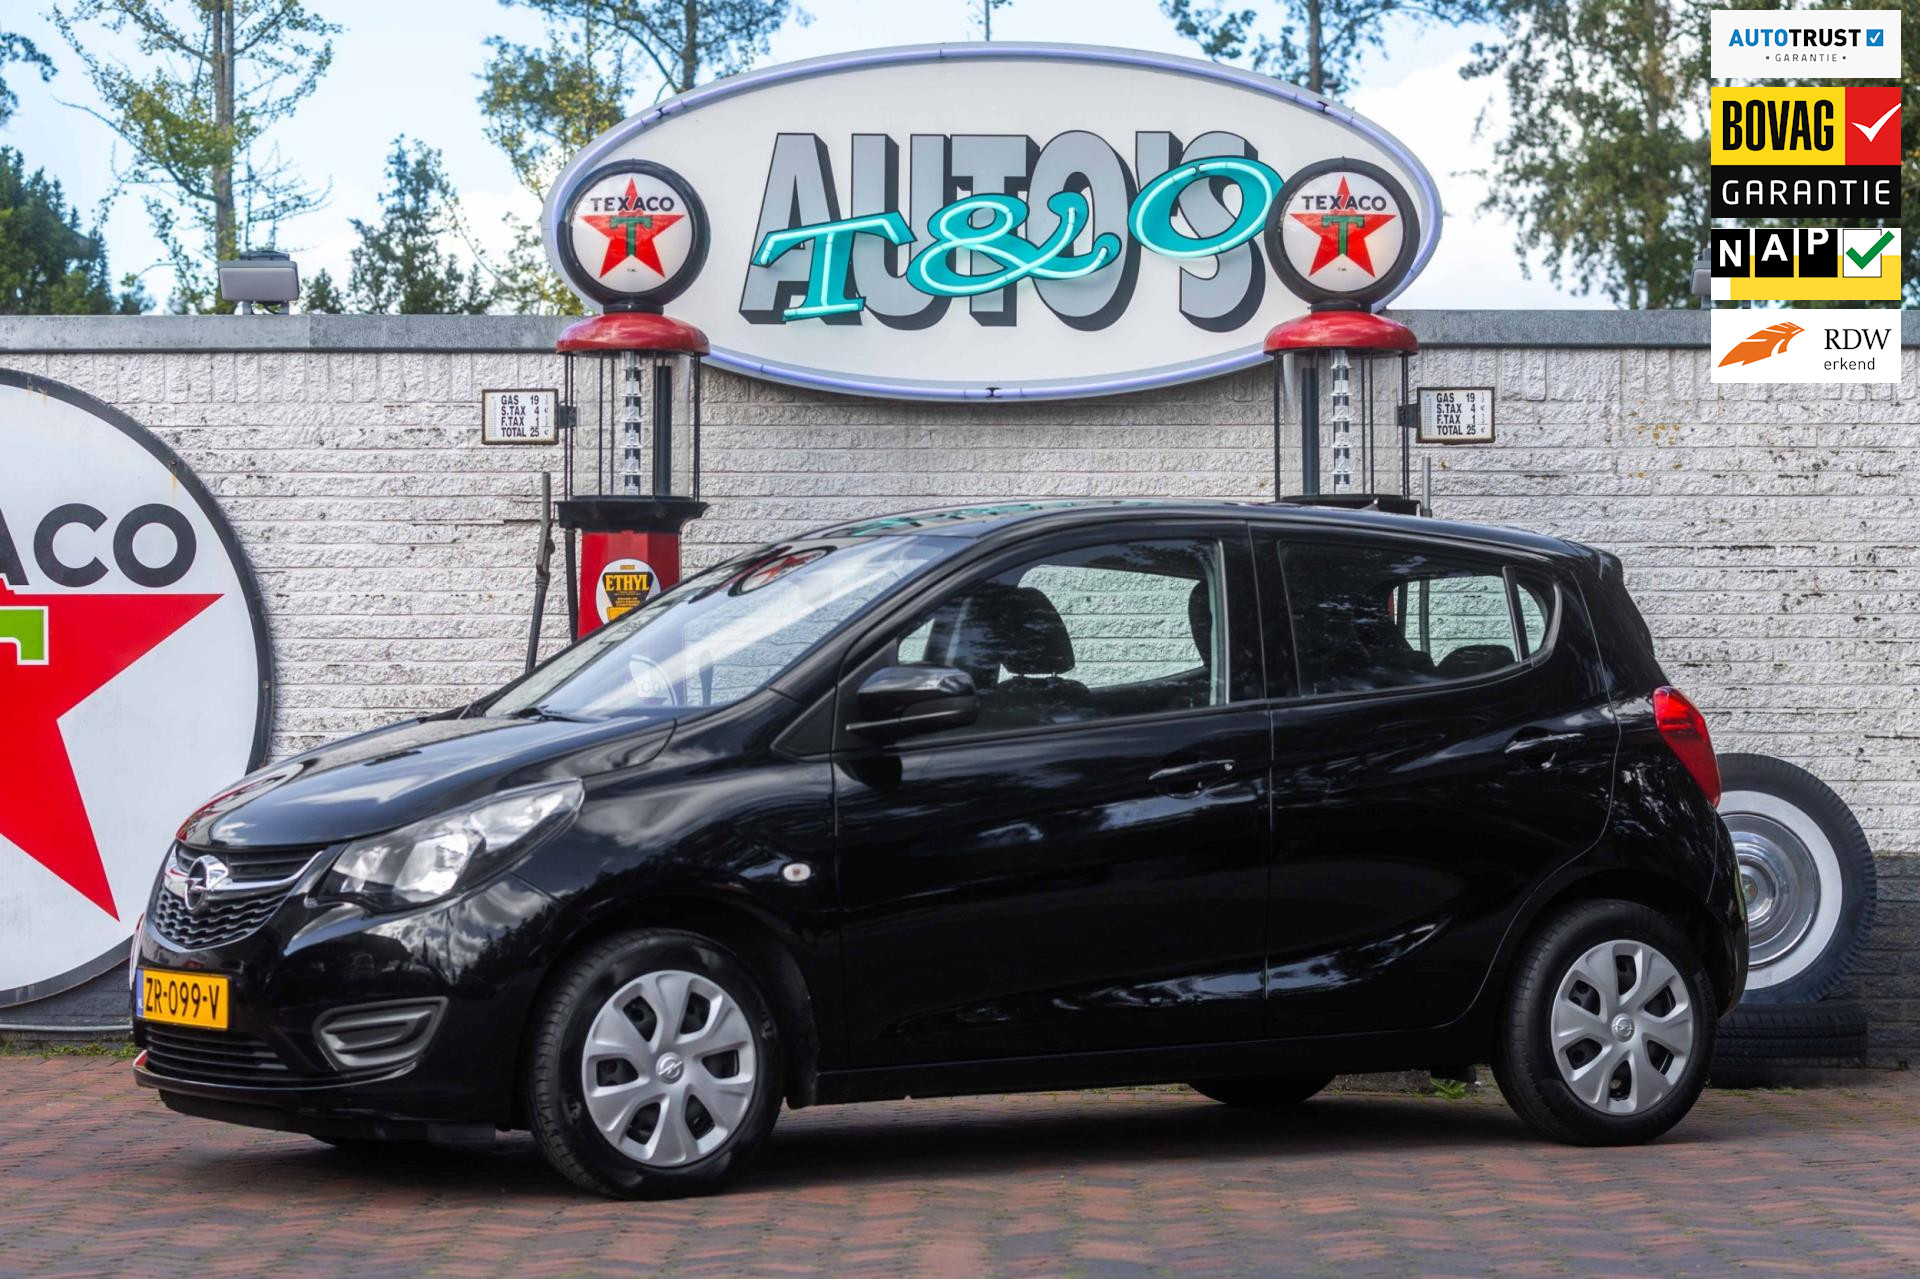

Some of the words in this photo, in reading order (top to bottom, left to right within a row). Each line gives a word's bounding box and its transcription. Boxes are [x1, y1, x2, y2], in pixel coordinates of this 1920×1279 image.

[590, 196, 675, 212] TEXACO
[1301, 195, 1387, 212] TEXACO
[738, 130, 1266, 332] AUTO'S
[501, 395, 519, 405] GAS
[1436, 393, 1455, 403] GAS
[501, 406, 526, 416] S.TAX
[1436, 403, 1462, 413] S.TAX
[501, 417, 525, 426] F.TAX
[1436, 414, 1461, 424] F.TAX
[501, 427, 527, 437] TOTAL
[1436, 425, 1463, 435] TOTAL
[605, 574, 650, 592] ETHYL
[146, 977, 220, 1020] ZR-099-V
